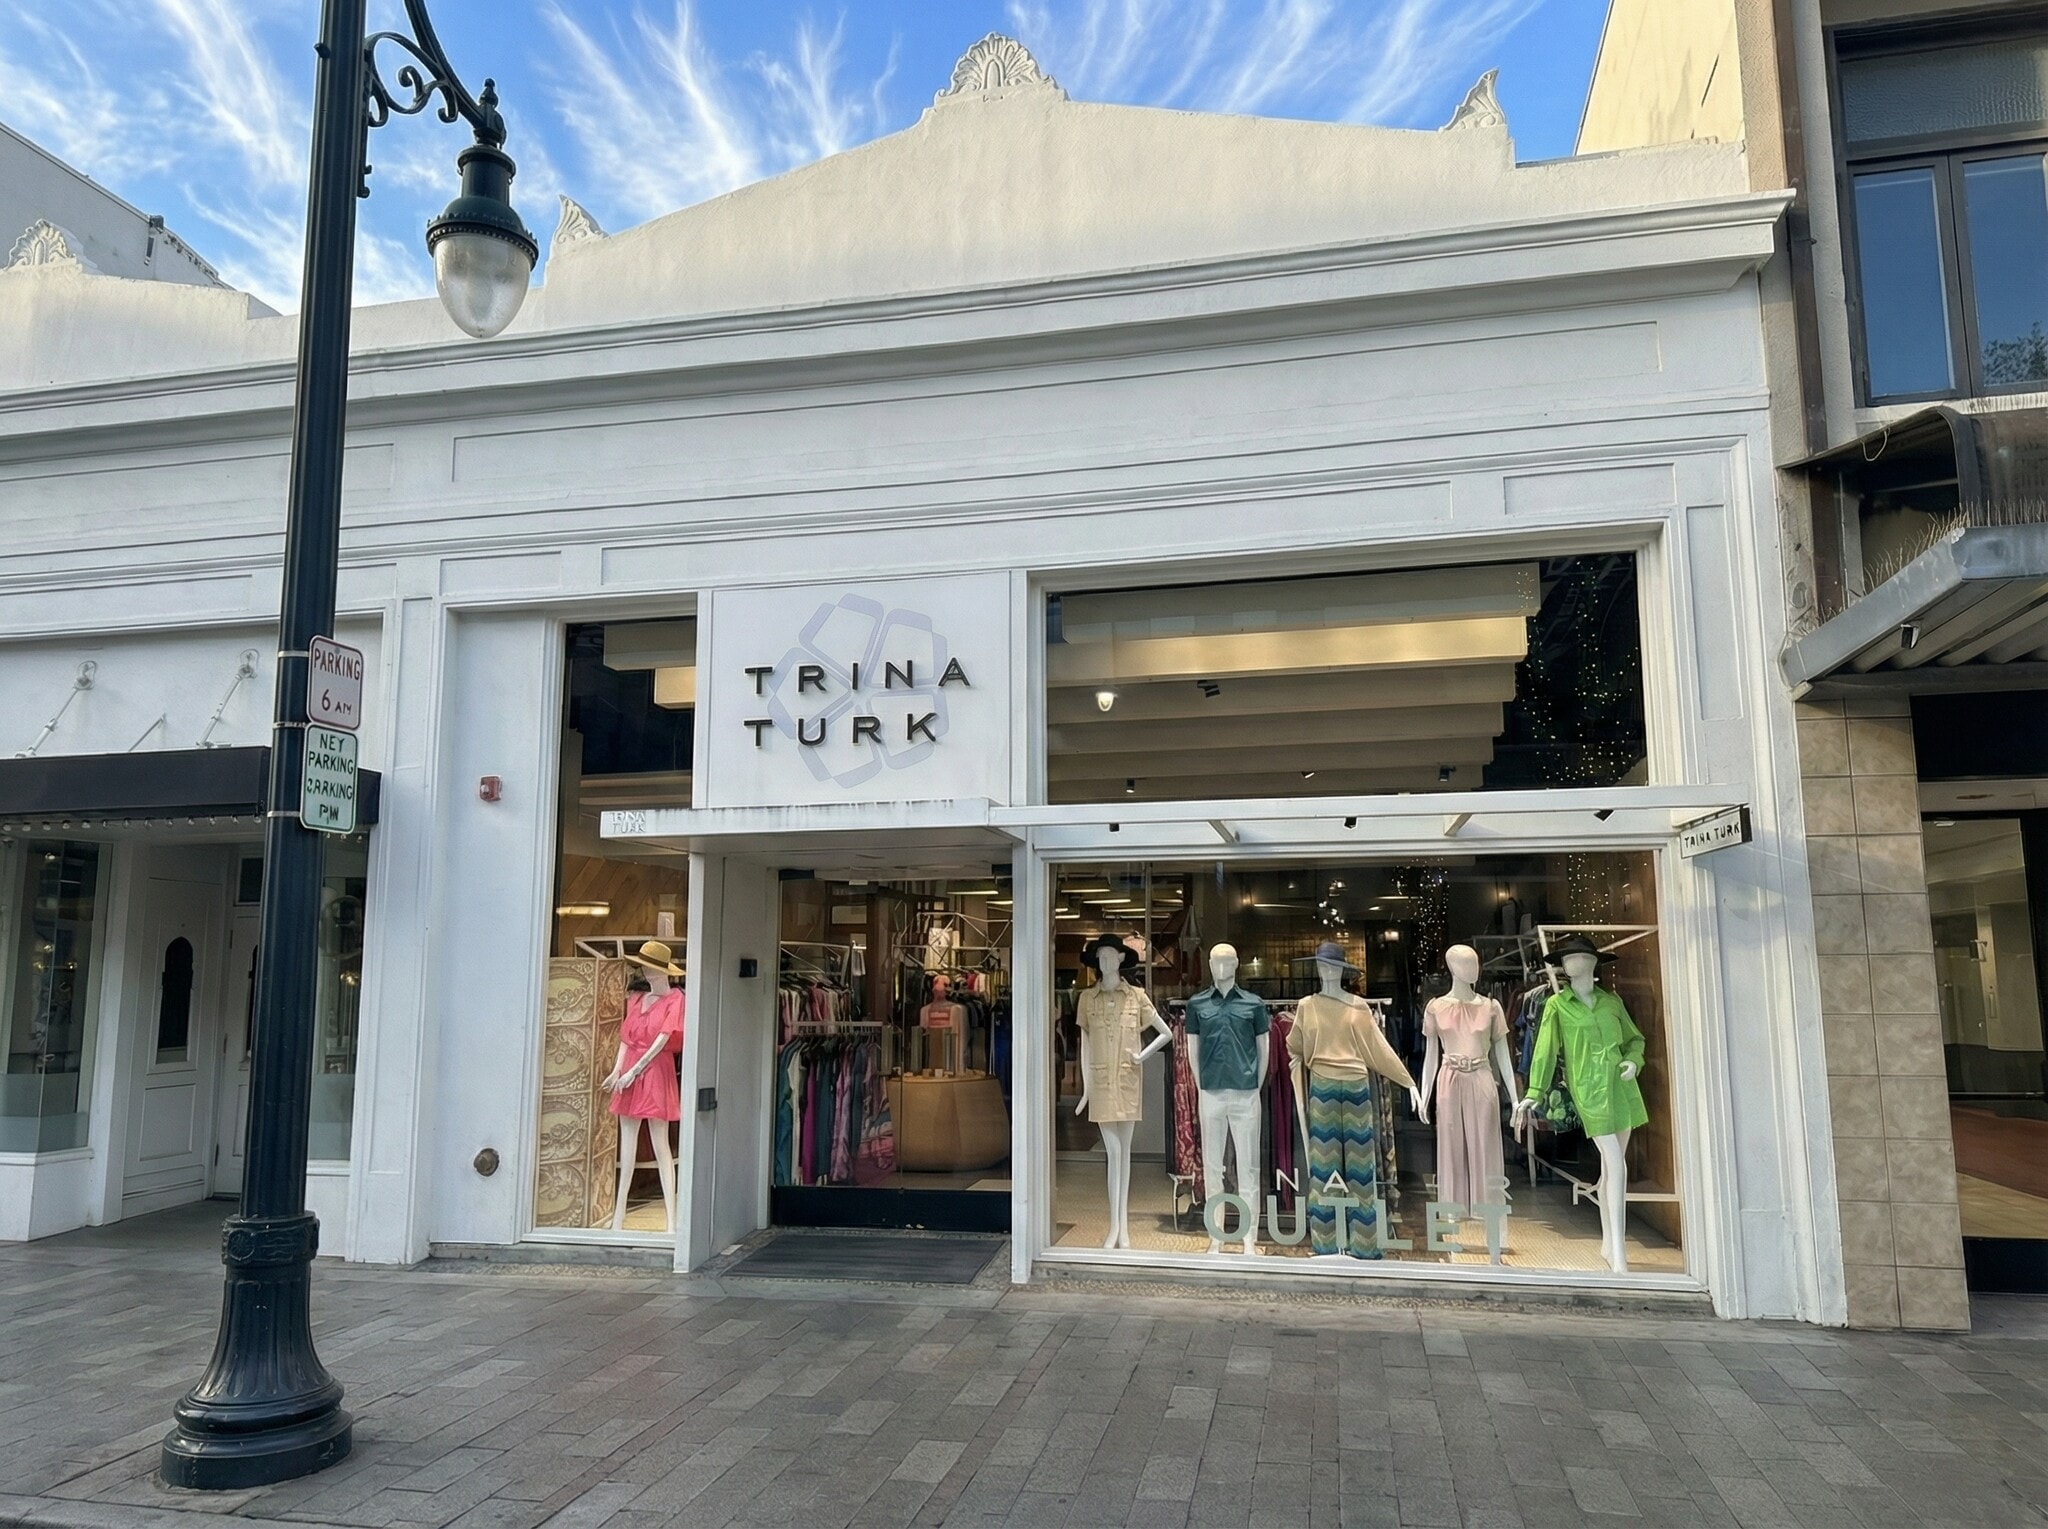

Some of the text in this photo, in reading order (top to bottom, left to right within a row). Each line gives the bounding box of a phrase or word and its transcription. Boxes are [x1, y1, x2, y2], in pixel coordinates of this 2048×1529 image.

[313, 648, 361, 680] PARKING
[744, 657, 971, 695] TRINA
[321, 689, 331, 711] 6
[743, 712, 938, 747] TURK
[308, 751, 354, 775] PARKING
[1713, 821, 1740, 841] TURK
[1203, 1192, 1512, 1265] OUTLET
